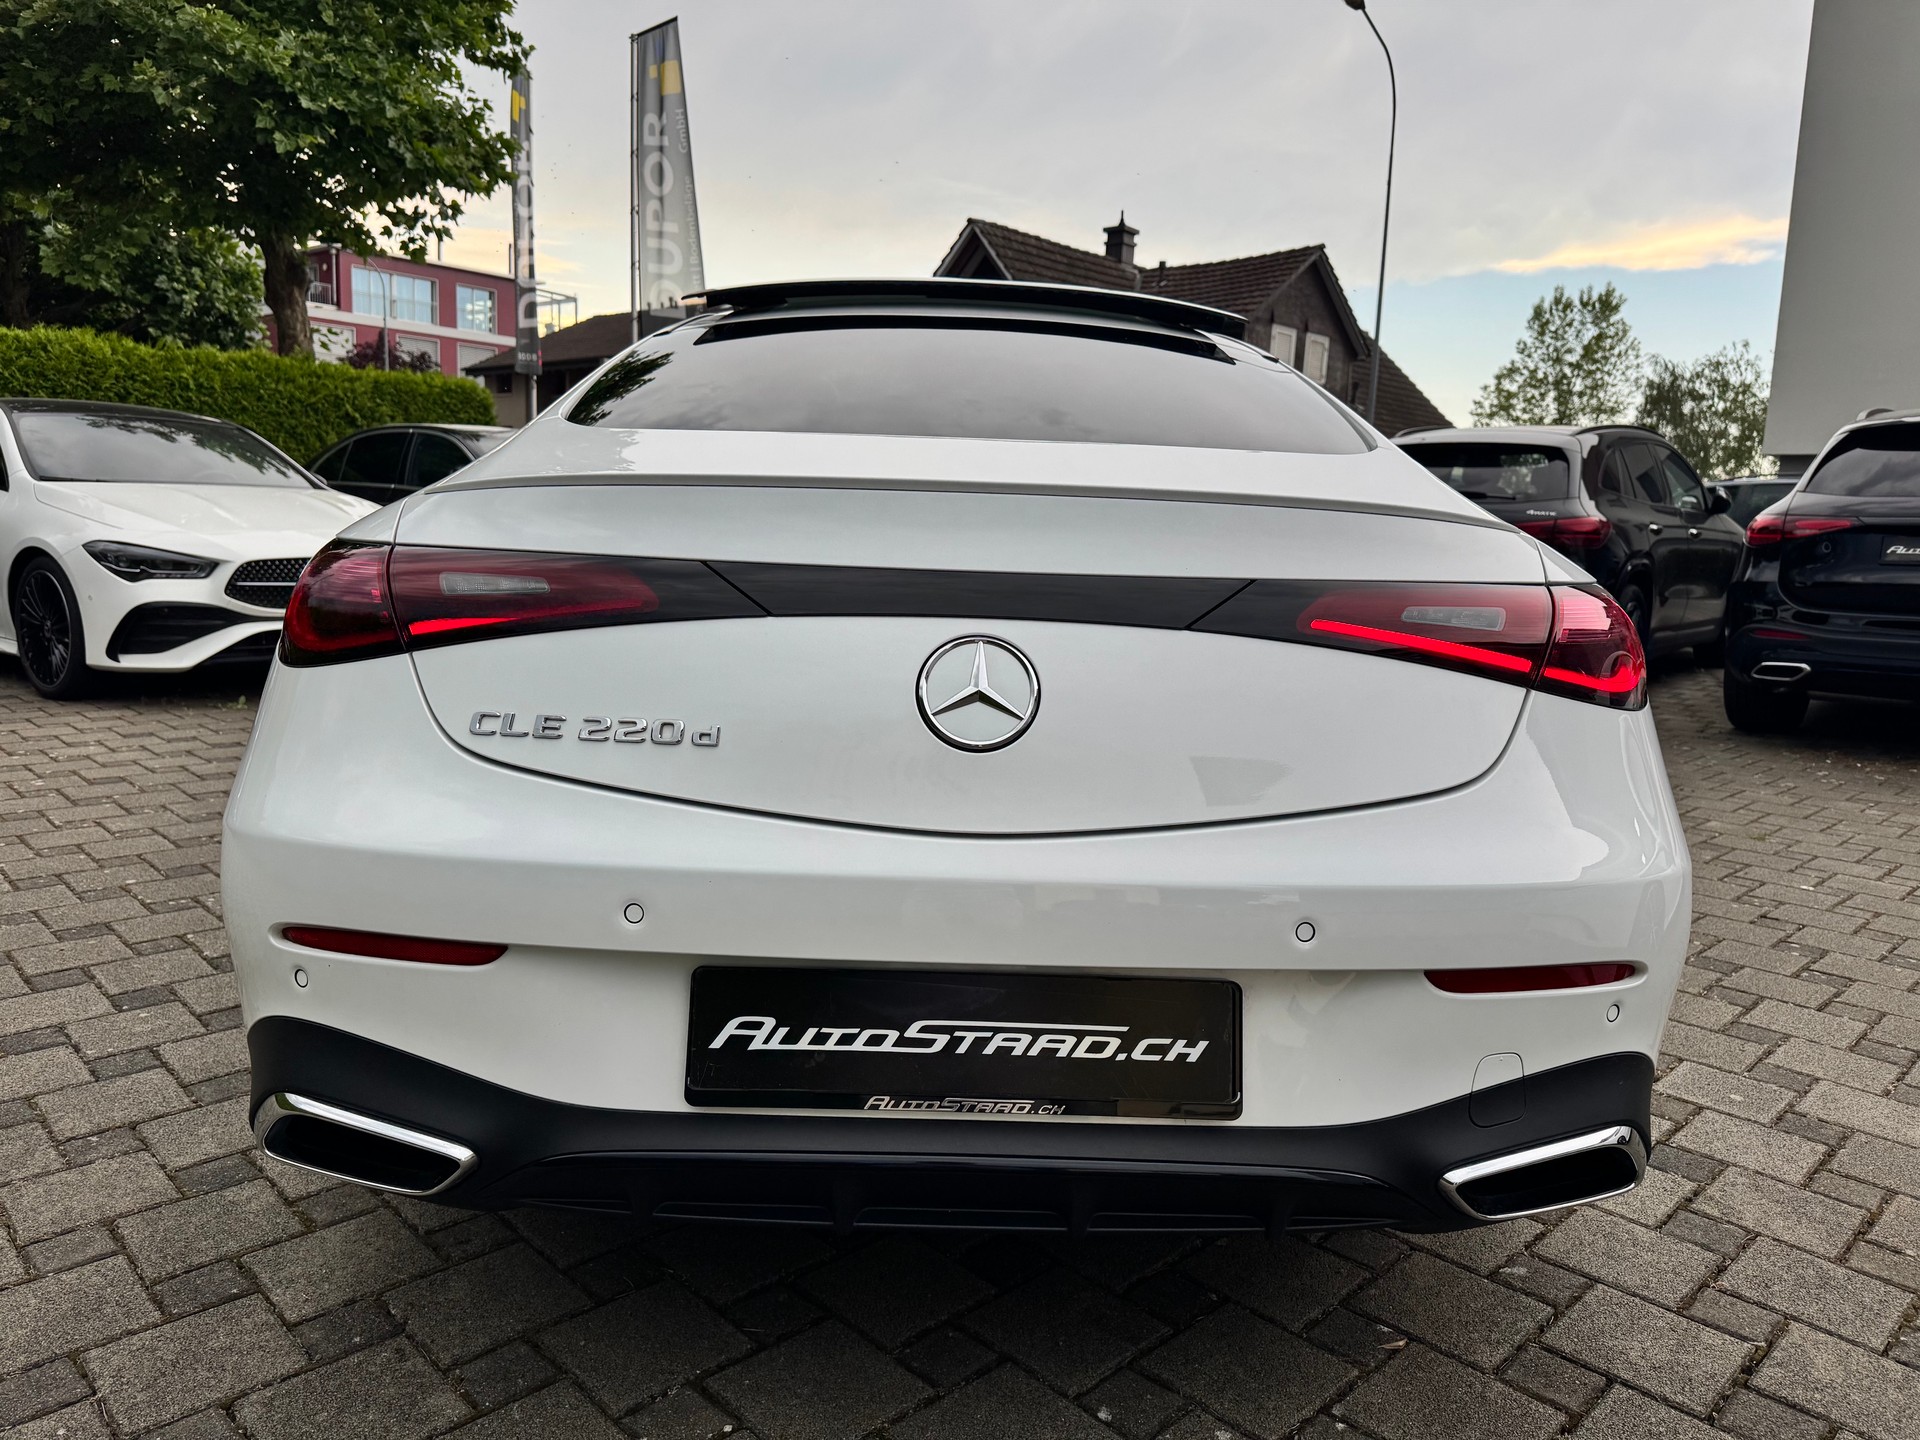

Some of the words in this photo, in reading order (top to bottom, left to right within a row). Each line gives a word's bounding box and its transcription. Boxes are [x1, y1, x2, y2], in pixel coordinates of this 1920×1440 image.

[675, 108, 688, 154] GmbH
[643, 111, 687, 318] DUPOR
[469, 711, 567, 739] CLE
